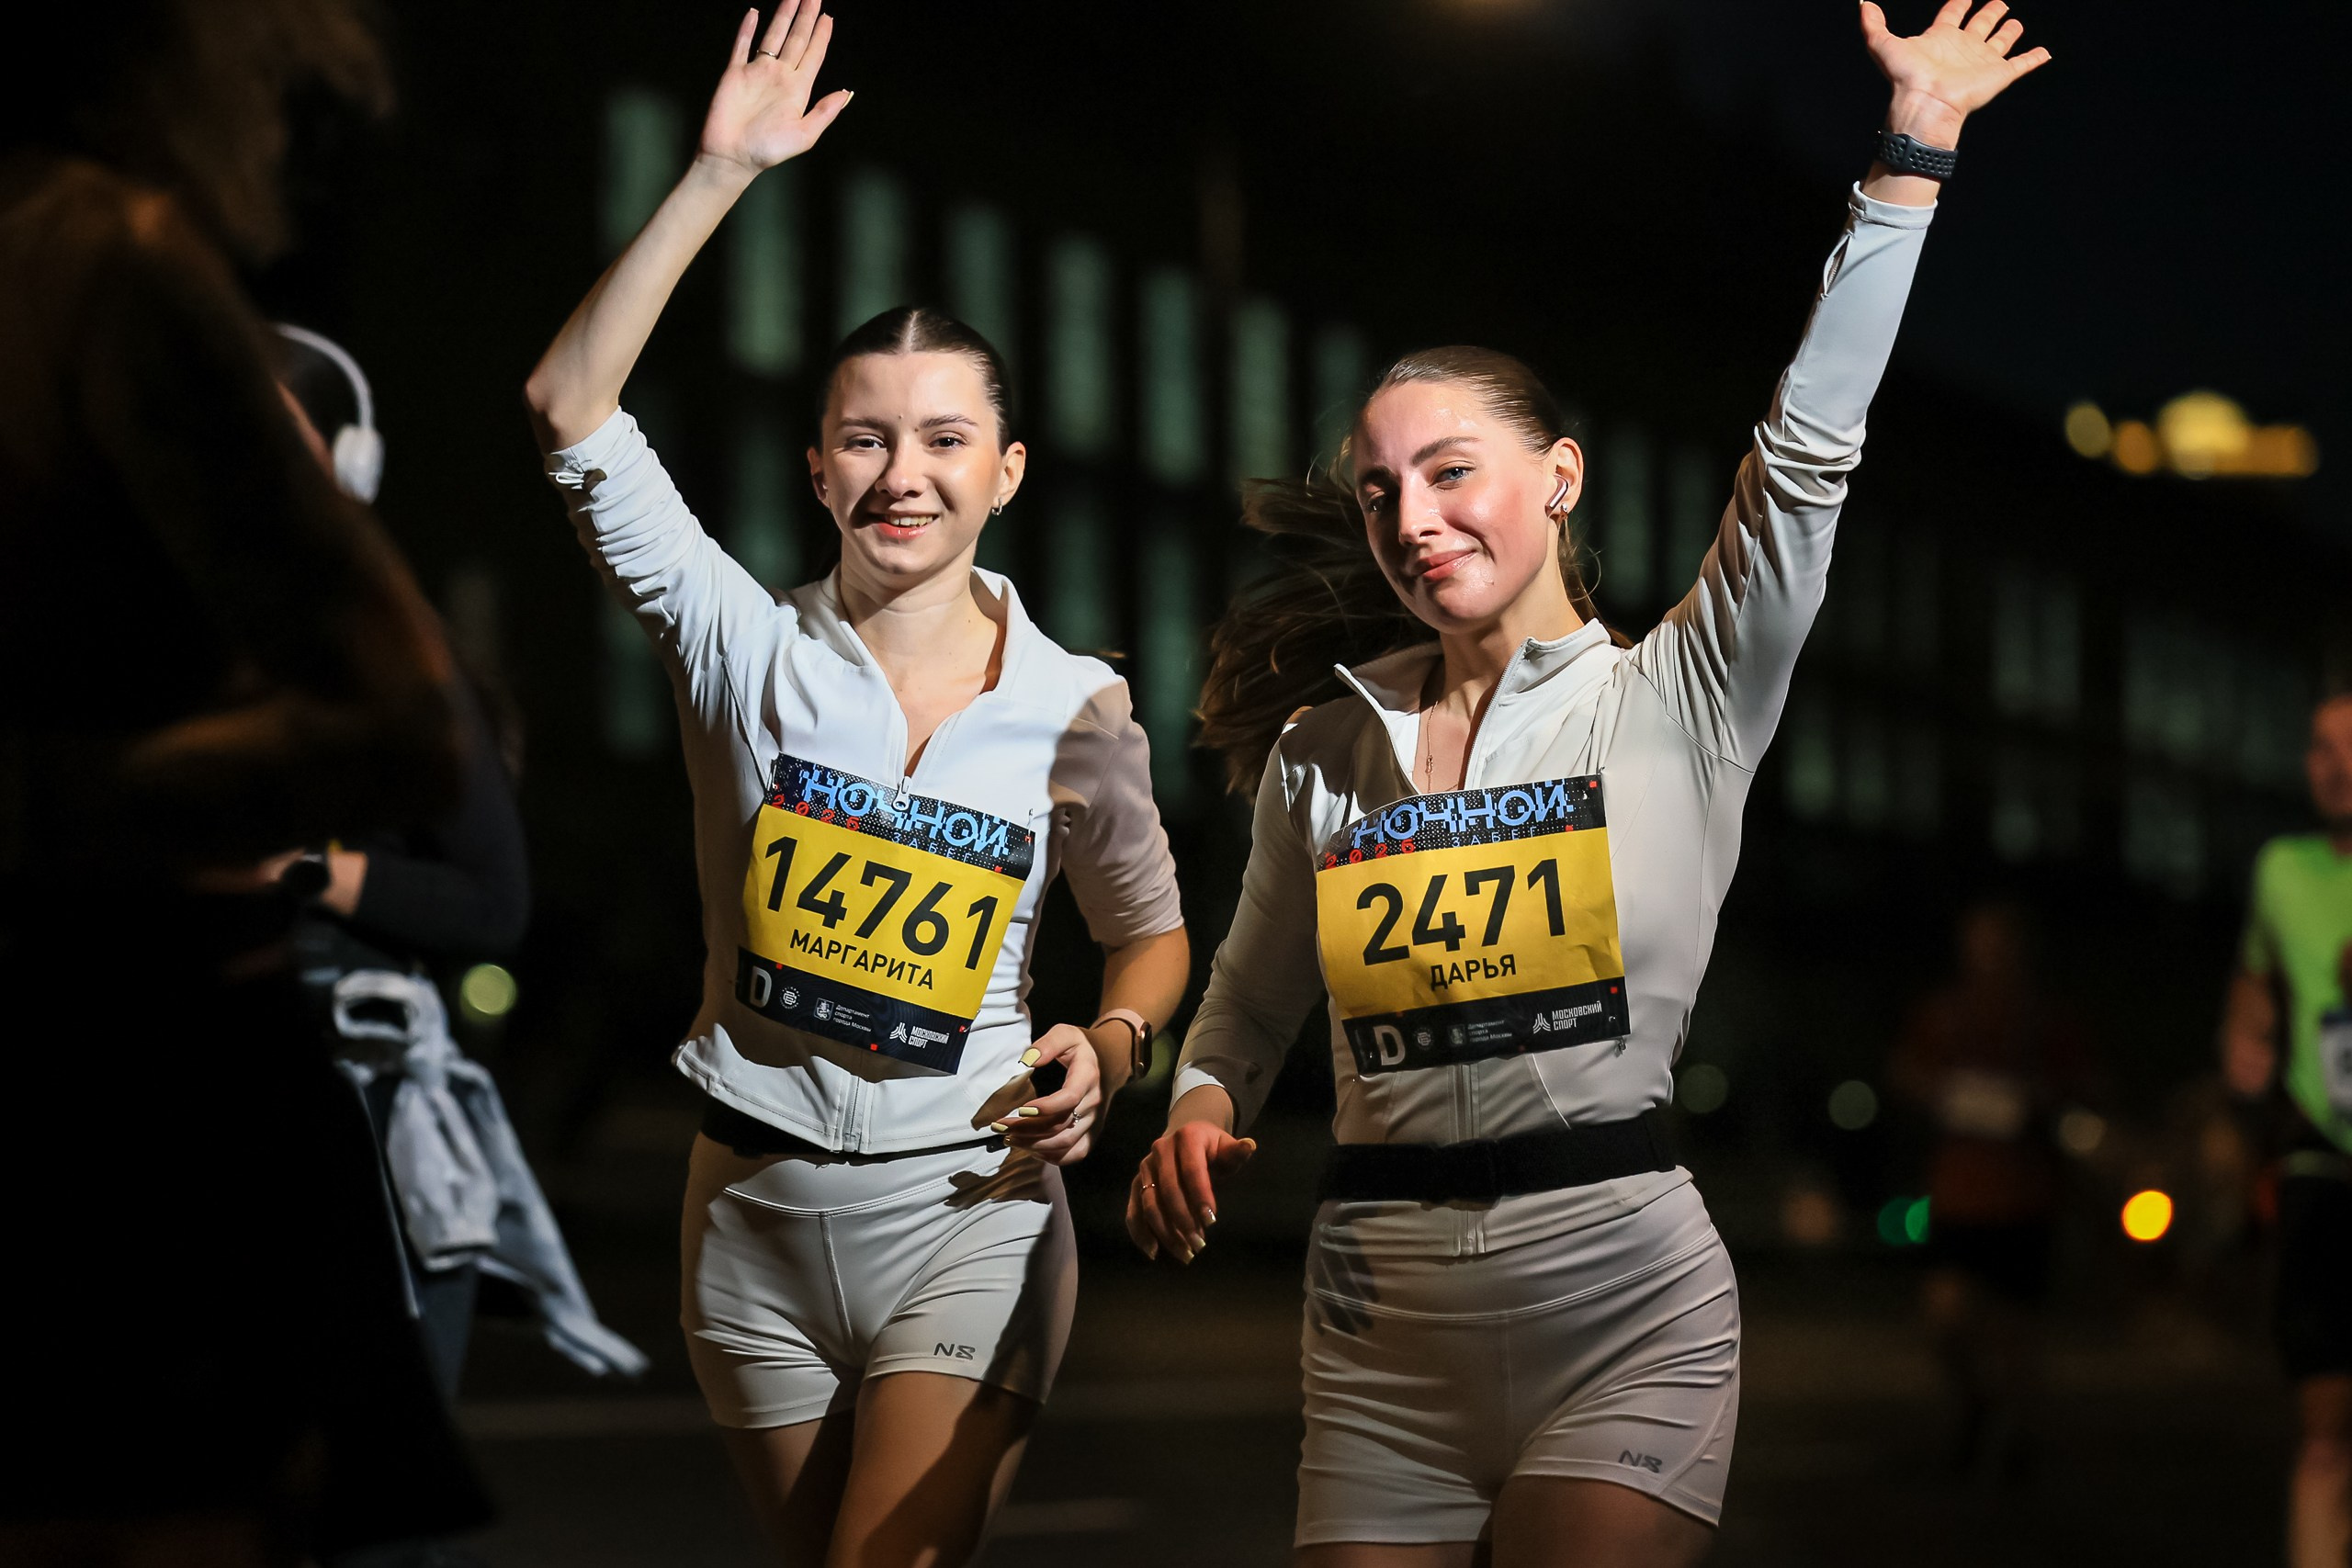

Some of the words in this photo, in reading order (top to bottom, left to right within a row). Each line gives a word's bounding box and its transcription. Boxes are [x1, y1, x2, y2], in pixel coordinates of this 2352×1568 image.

[772, 794, 860, 831] 2026
[1351, 779, 1574, 849] НОЧНОЙ
[892, 831, 972, 863] ЗАБЕГ
[1325, 839, 1416, 870] 2026
[1451, 827, 1537, 848] ЗАБЕГ
[764, 835, 999, 971] 14761
[1356, 858, 1566, 966] 2471
[789, 929, 934, 991] МАРГАРИТА
[1430, 953, 1518, 992] ДАРЬЯ
[750, 965, 773, 1009] D
[1552, 999, 1602, 1021] МОСКОВСКИЙ
[1553, 1017, 1577, 1031] СПОРТ
[1373, 1024, 1406, 1066] D
